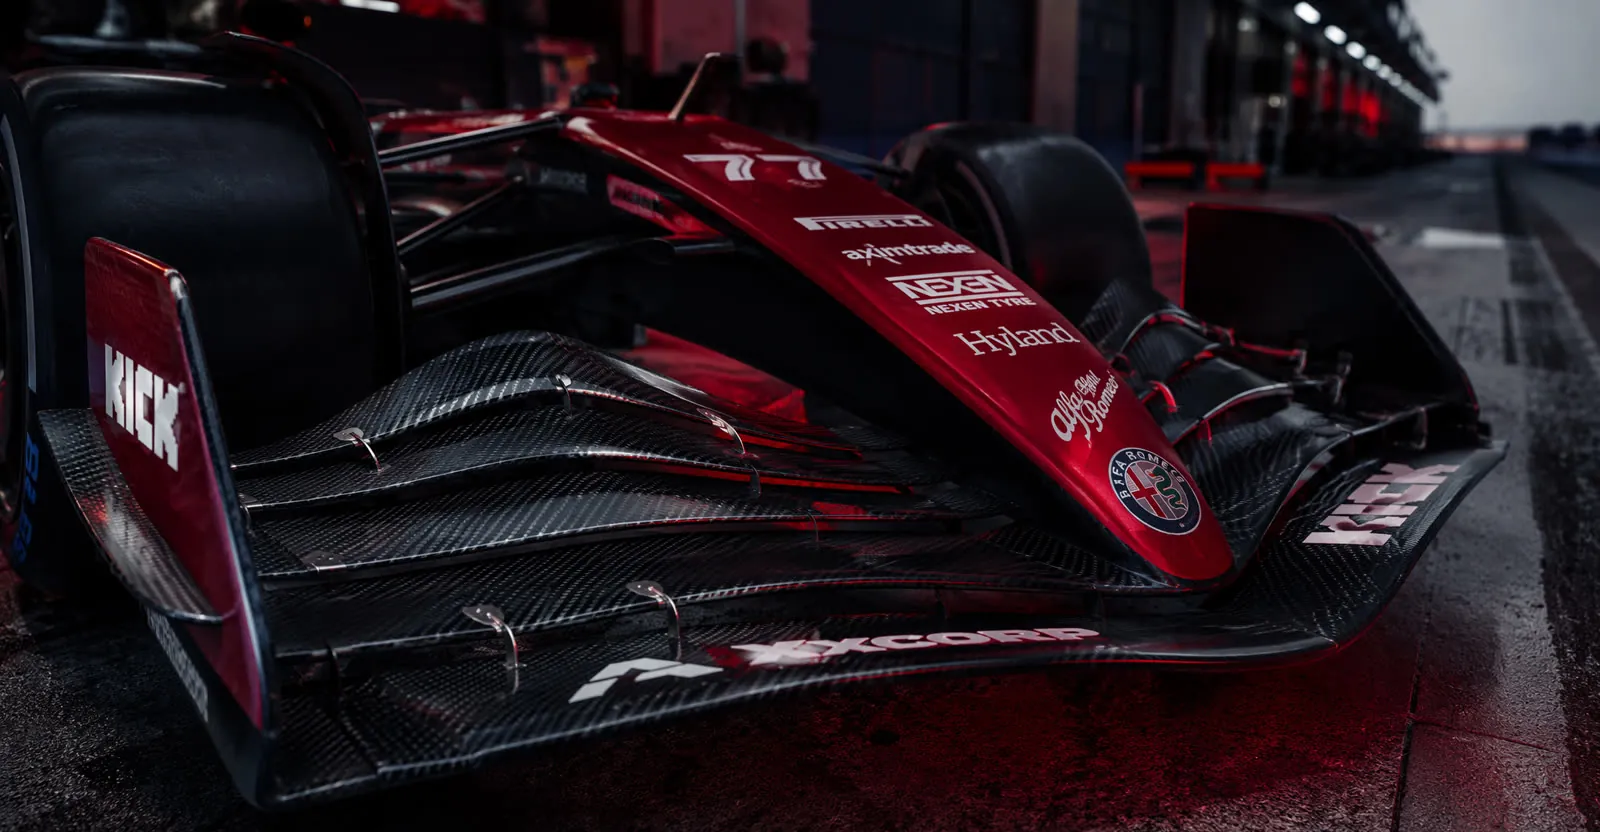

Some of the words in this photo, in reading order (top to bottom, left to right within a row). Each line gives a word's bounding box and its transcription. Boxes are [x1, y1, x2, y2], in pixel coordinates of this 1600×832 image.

[684, 154, 826, 181] 77
[793, 214, 935, 231] PIRELLI
[841, 243, 976, 267] aximtrade
[892, 274, 1017, 299] NEXEN
[923, 300, 990, 315] NEXEN
[987, 297, 1037, 308] TYRE
[953, 322, 1080, 357] Hyland
[105, 343, 180, 472] KICK
